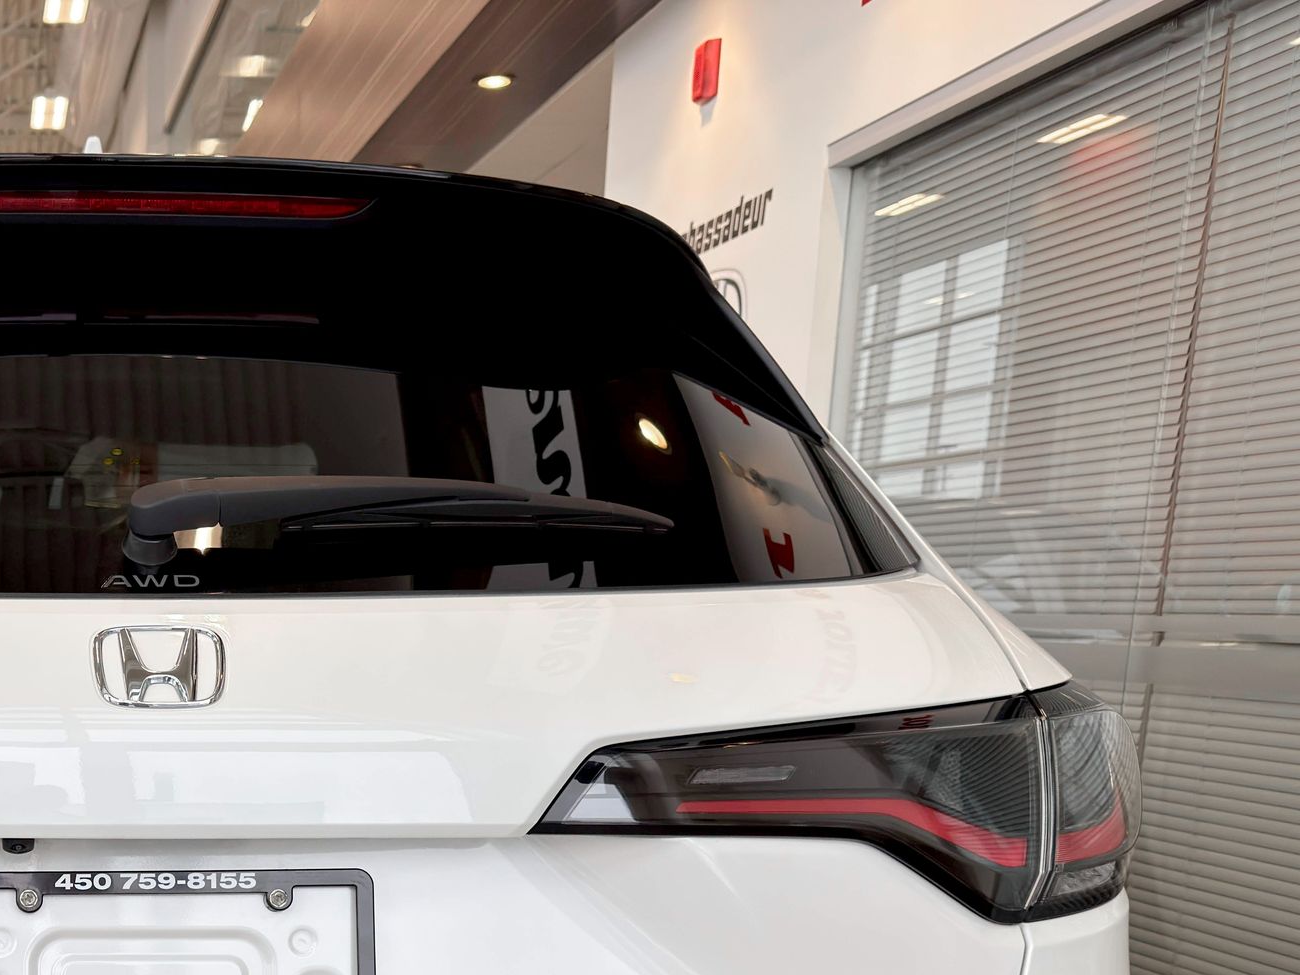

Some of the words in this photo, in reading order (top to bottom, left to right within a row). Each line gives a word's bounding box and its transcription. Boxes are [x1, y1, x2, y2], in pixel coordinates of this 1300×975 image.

[101, 573, 201, 588] AWD
[54, 873, 112, 891] 450
[119, 873, 257, 891] 759-8155
